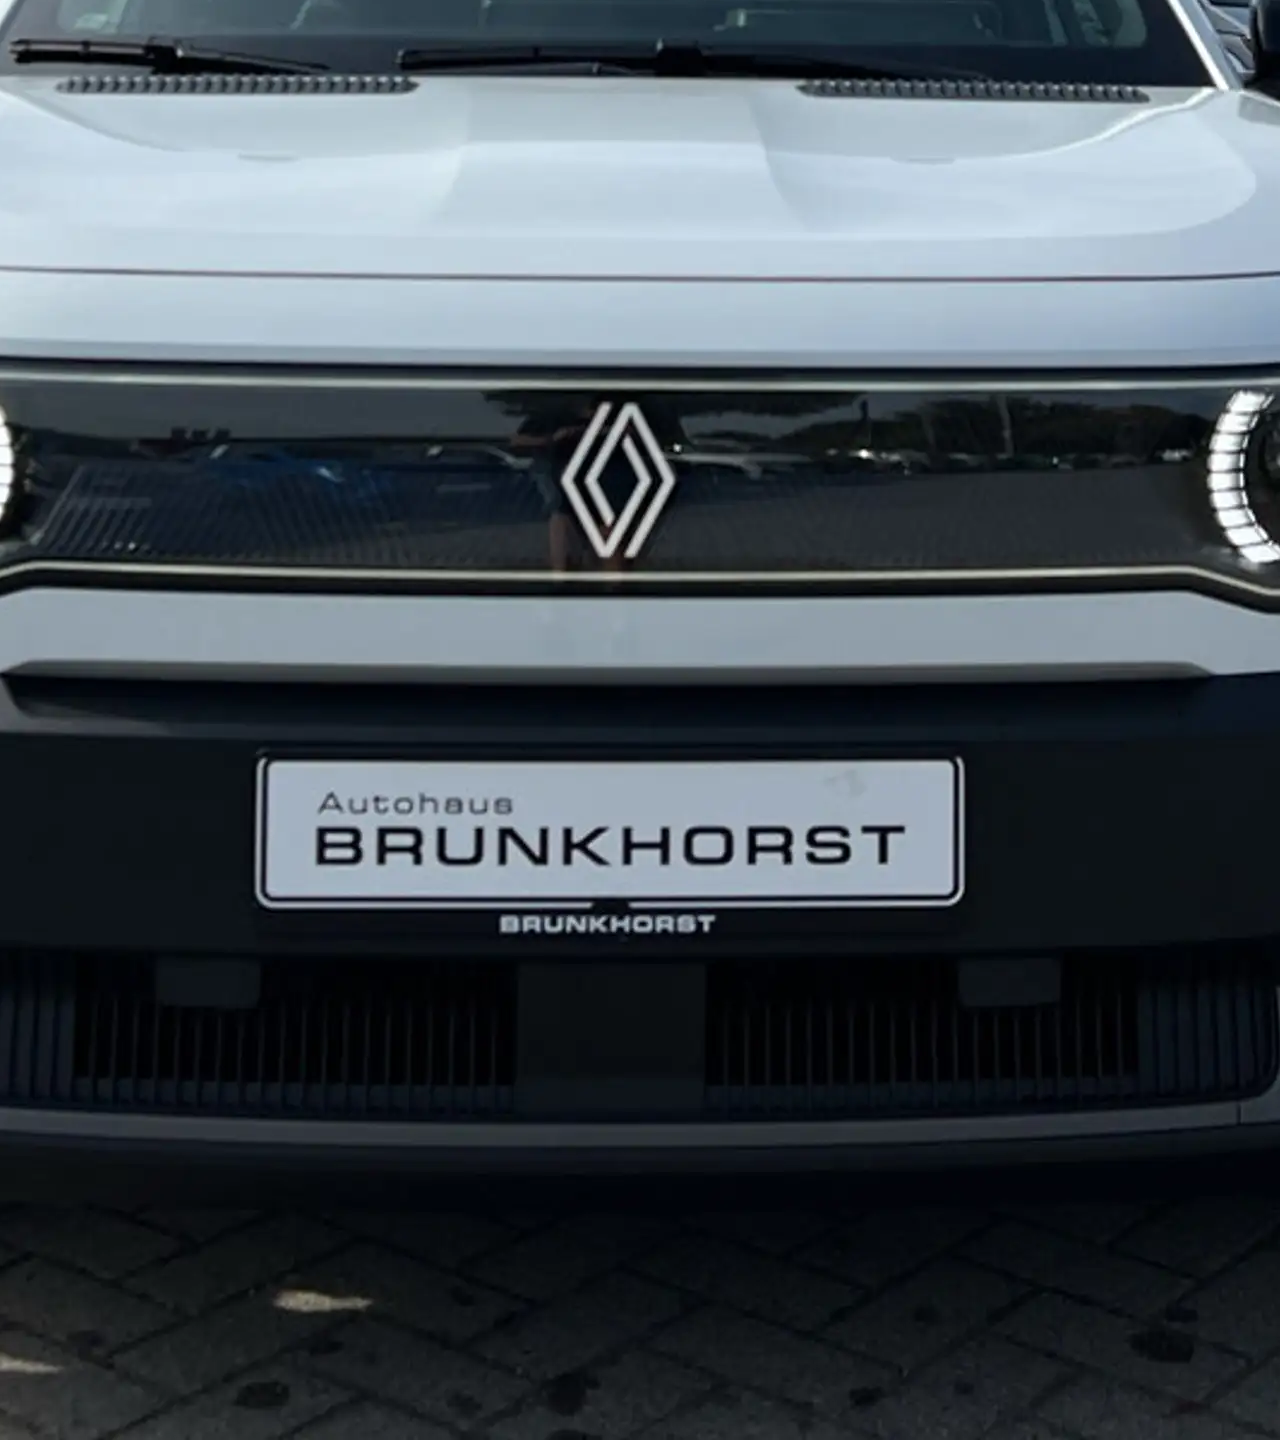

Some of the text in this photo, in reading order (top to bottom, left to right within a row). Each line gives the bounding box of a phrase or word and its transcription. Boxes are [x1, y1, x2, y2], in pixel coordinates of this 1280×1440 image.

[317, 792, 514, 816] Autohaus
[315, 825, 906, 866] BRUNKHORST
[499, 914, 716, 934] BRUNKHORST
